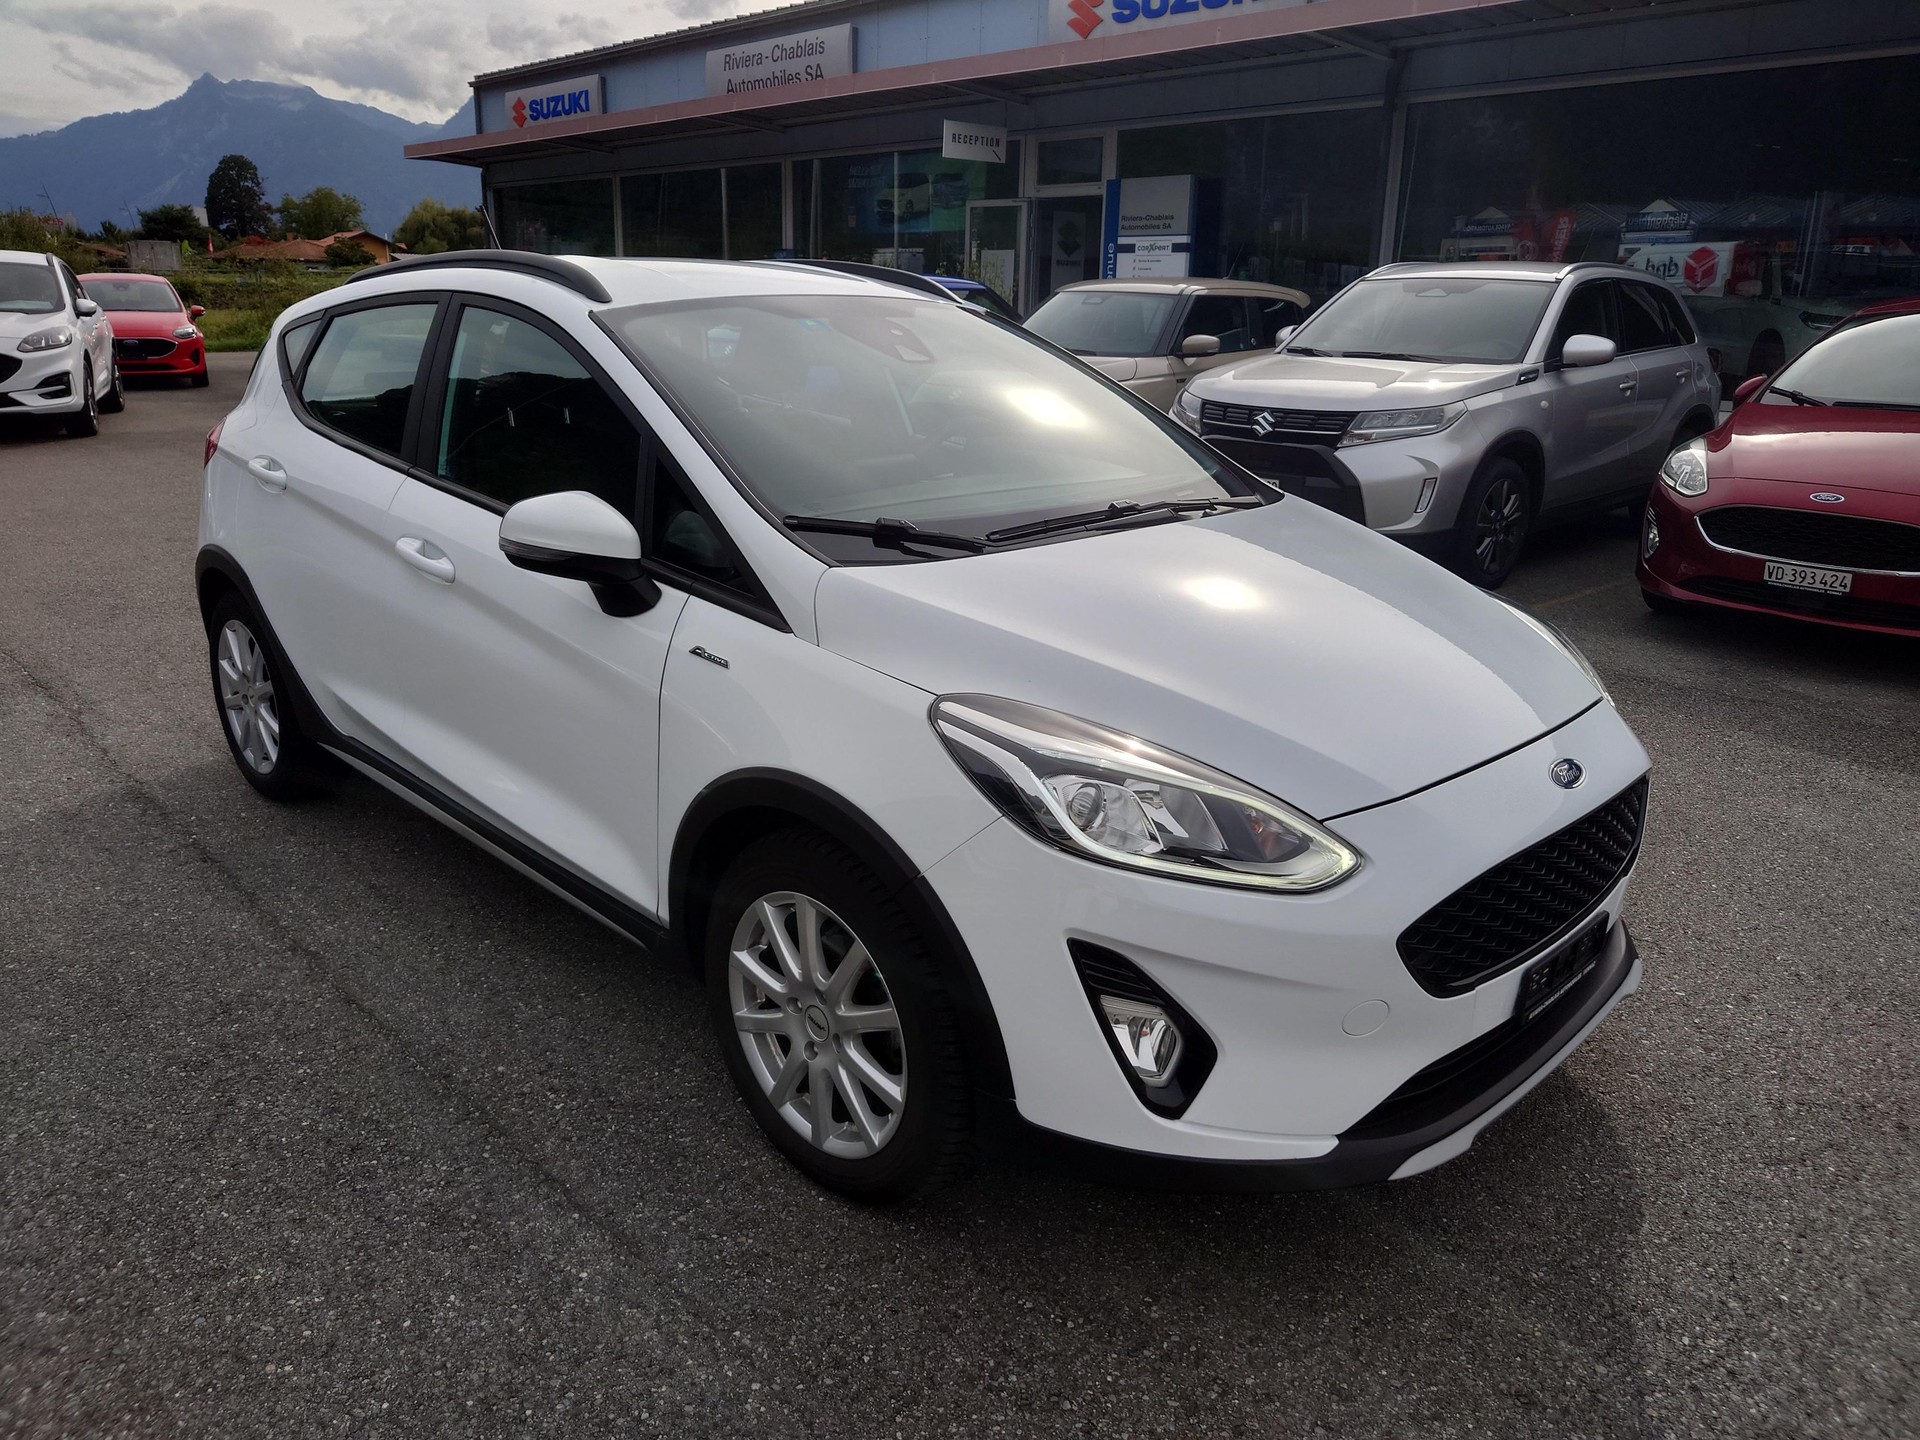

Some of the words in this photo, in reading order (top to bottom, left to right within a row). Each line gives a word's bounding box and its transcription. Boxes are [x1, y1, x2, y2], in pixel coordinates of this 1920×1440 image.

[726, 69, 801, 95] Automobiles
[805, 63, 825, 82] SA
[529, 89, 590, 121] SUZUKI
[951, 132, 1000, 148] RECEPTION
[1120, 223, 1160, 231] Automobiles
[1162, 222, 1172, 230] SA
[1557, 763, 1580, 784] Ford
